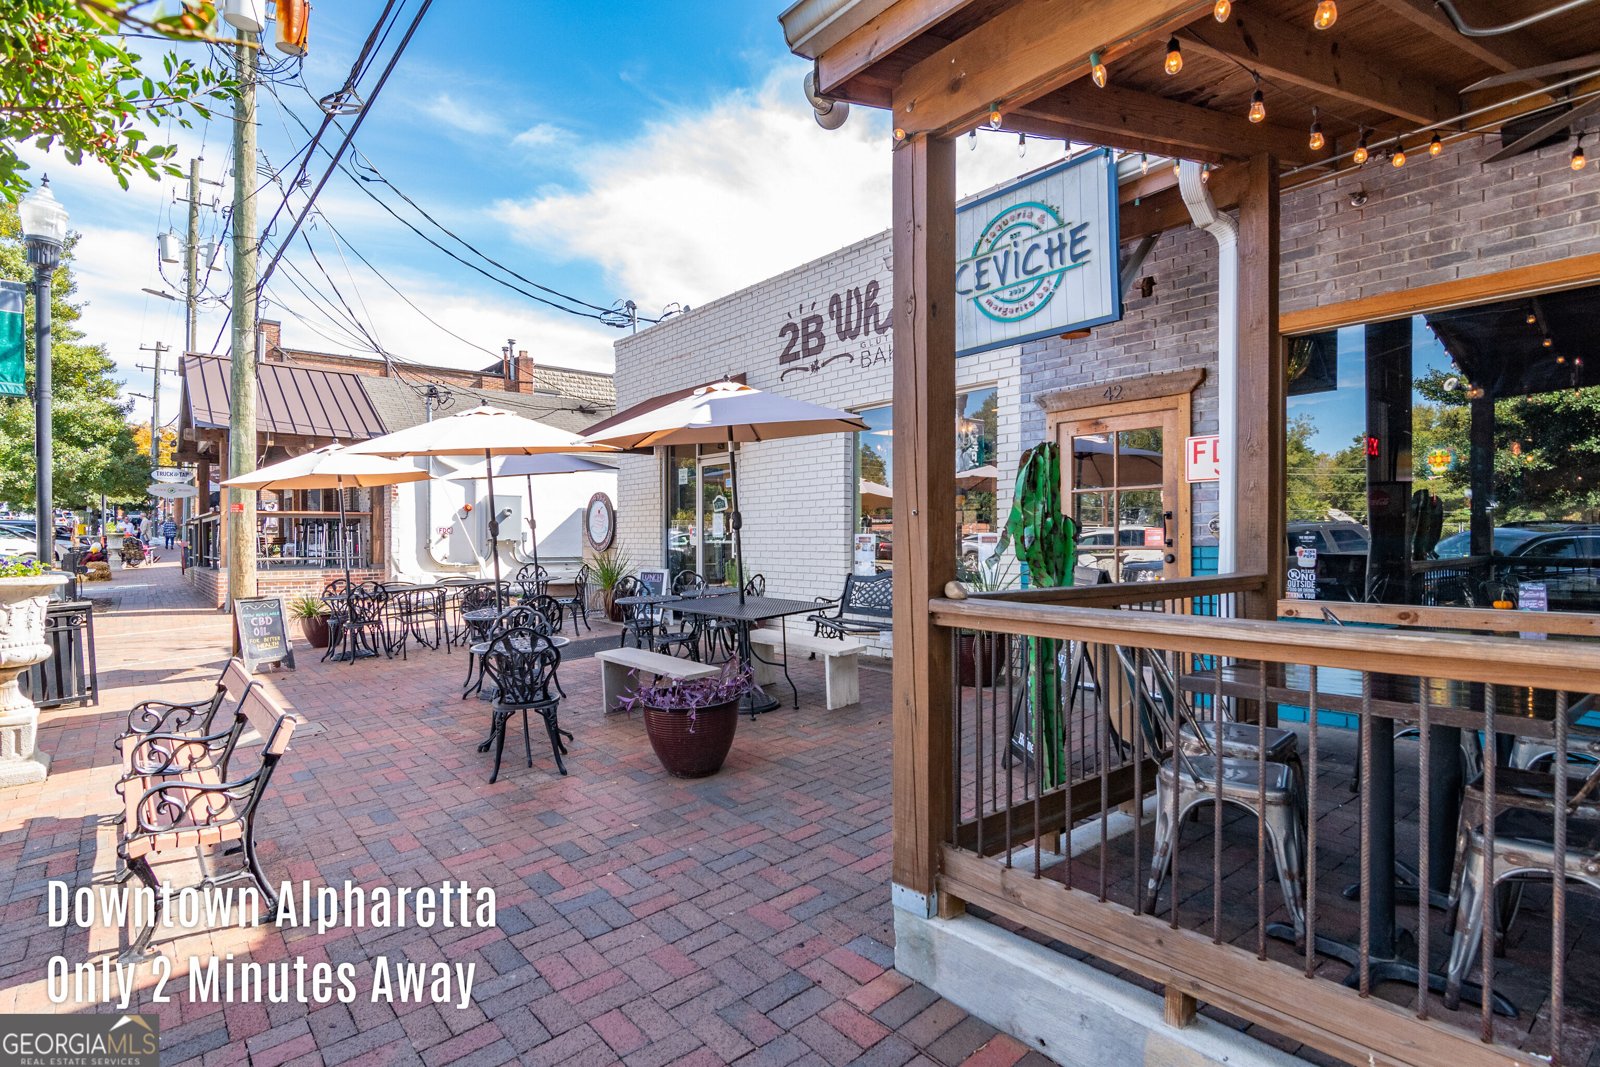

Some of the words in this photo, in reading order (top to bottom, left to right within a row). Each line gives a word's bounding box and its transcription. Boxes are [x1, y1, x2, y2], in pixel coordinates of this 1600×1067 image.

[778, 313, 826, 366] 2B
[1103, 385, 1124, 401] 42
[1287, 580, 1316, 588] OUTSIDE
[251, 617, 272, 626] CBD
